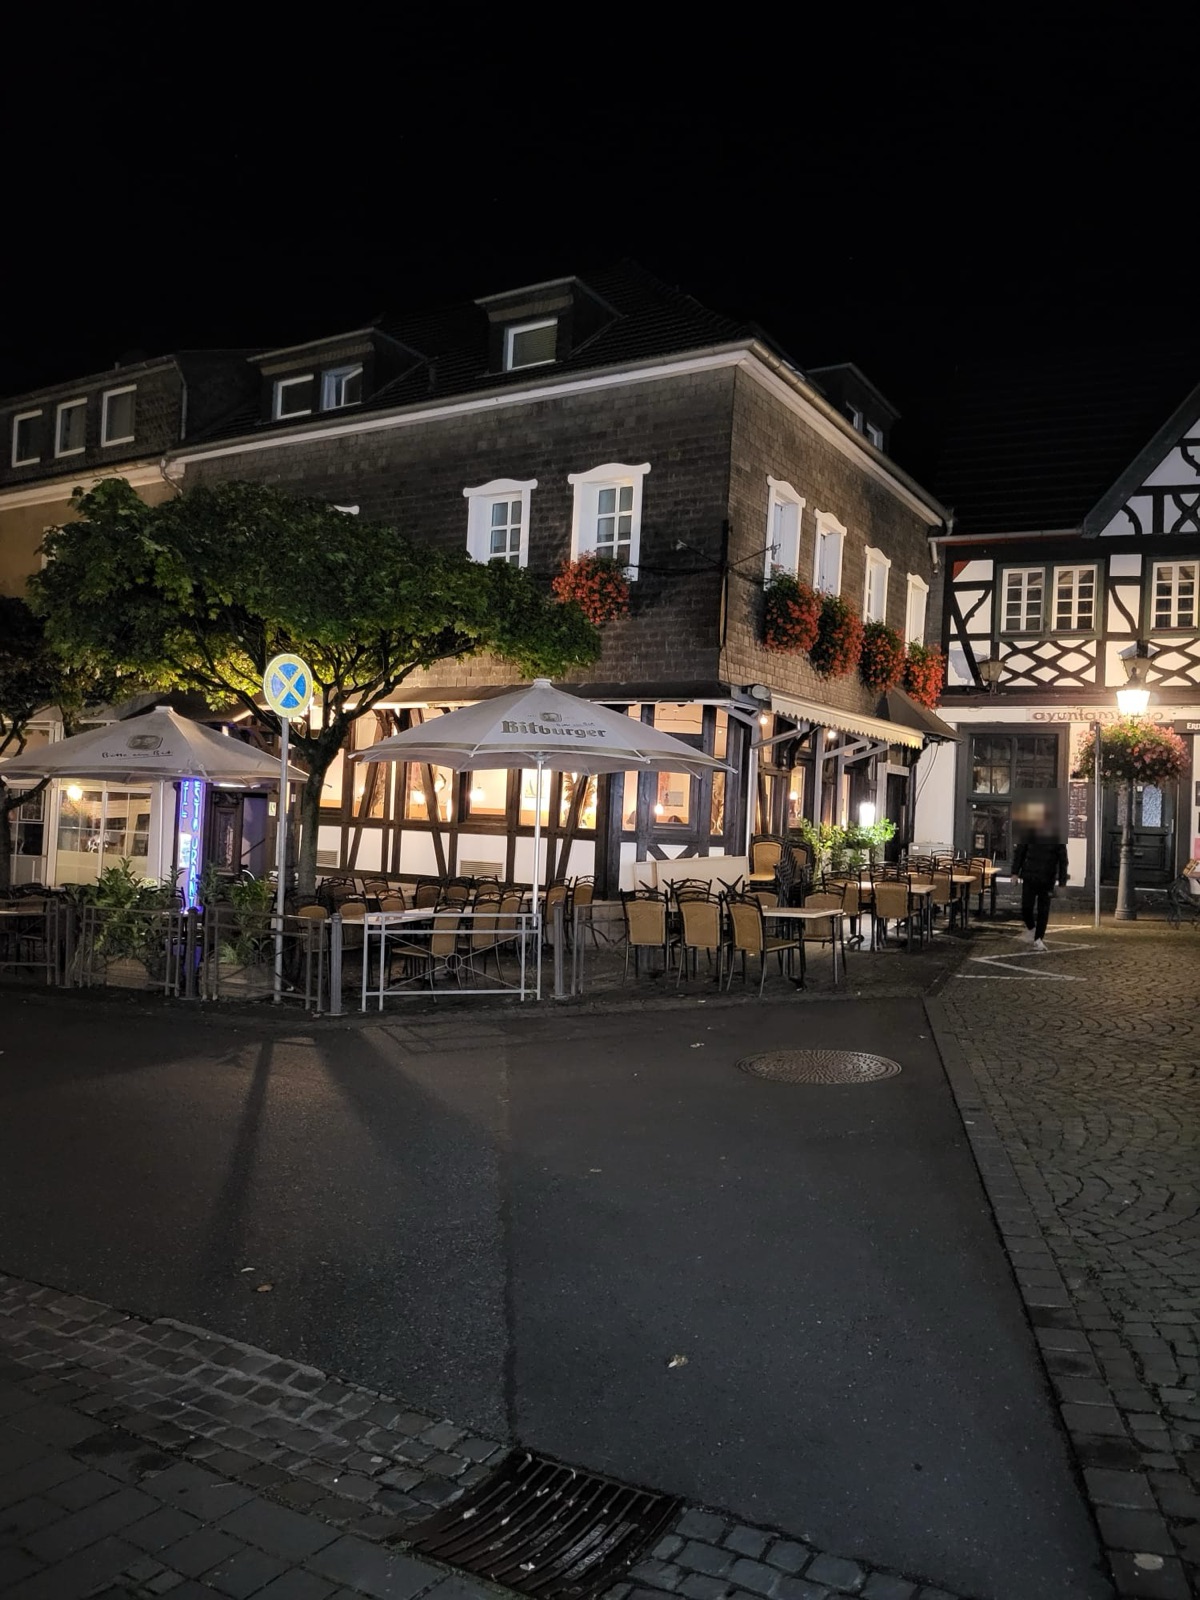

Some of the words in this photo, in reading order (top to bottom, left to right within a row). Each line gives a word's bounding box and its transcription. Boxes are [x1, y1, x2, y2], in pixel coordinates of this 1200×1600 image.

[1033, 708, 1164, 721] ayuntamo
[501, 720, 606, 738] Bitburger
[188, 780, 201, 908] ESTAURANT
